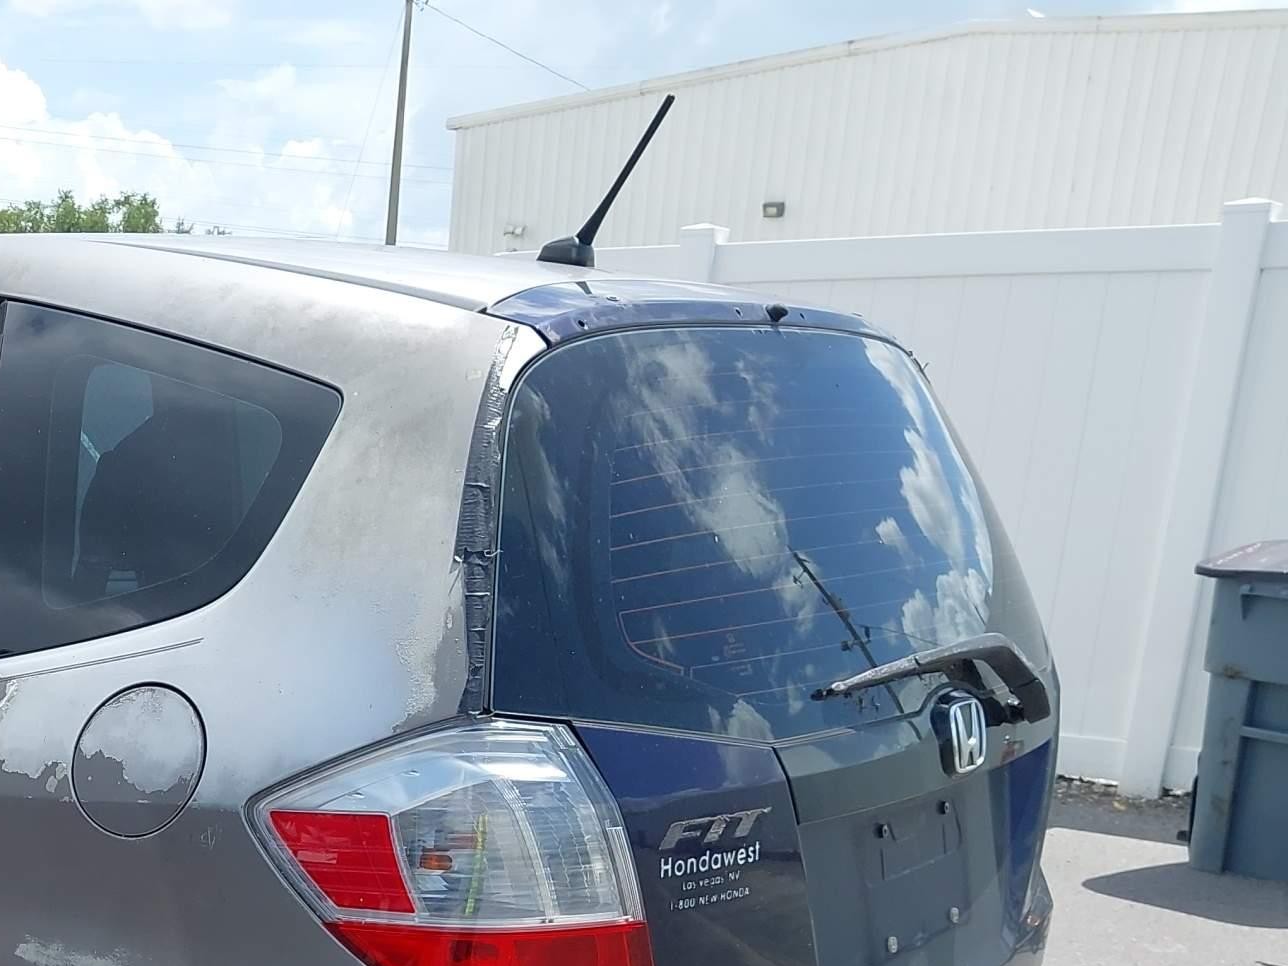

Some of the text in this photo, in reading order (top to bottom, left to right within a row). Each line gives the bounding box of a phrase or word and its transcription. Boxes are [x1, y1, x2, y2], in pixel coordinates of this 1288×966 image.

[659, 806, 773, 850] FIT
[660, 841, 761, 878] Hondawest
[728, 870, 740, 880] NV
[670, 887, 750, 911] 1-800 NEW HONDA
